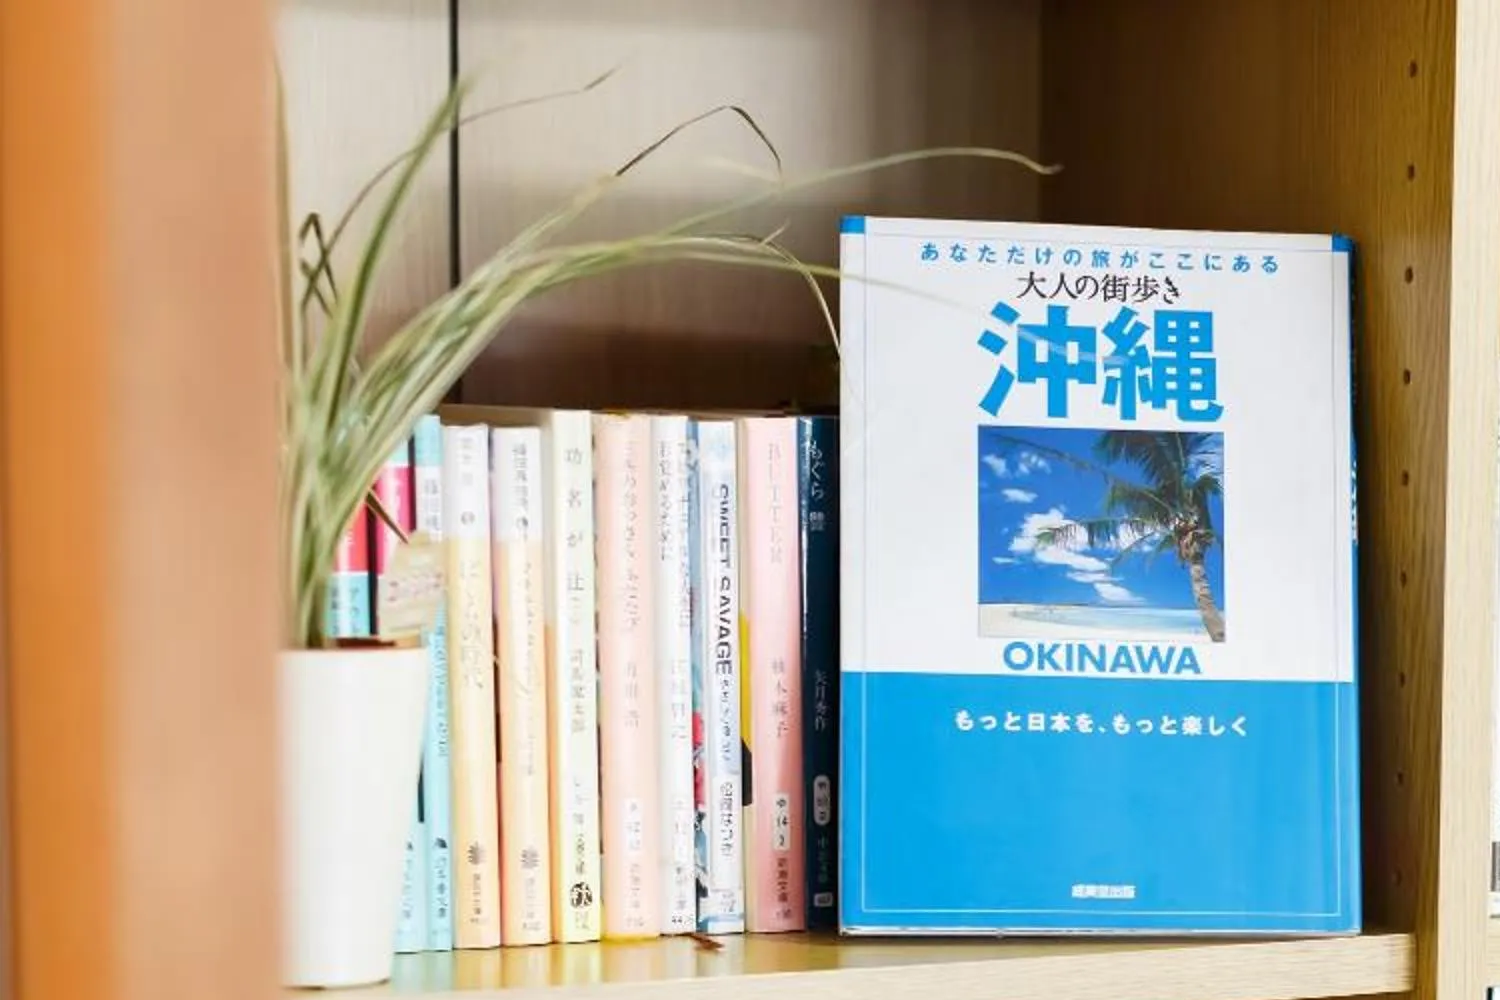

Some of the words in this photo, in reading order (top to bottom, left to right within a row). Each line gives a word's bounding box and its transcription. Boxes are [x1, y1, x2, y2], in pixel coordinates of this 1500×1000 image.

[920, 241, 1279, 274] あなただけの旅がここにある
[1016, 271, 1182, 304] 大人の街歩き
[976, 301, 1224, 423] 沖縄
[718, 577, 732, 675] SAVAGE
[1002, 641, 1203, 676] OKINAWA
[955, 709, 1248, 738] もっと日本を、もっと楽しく
